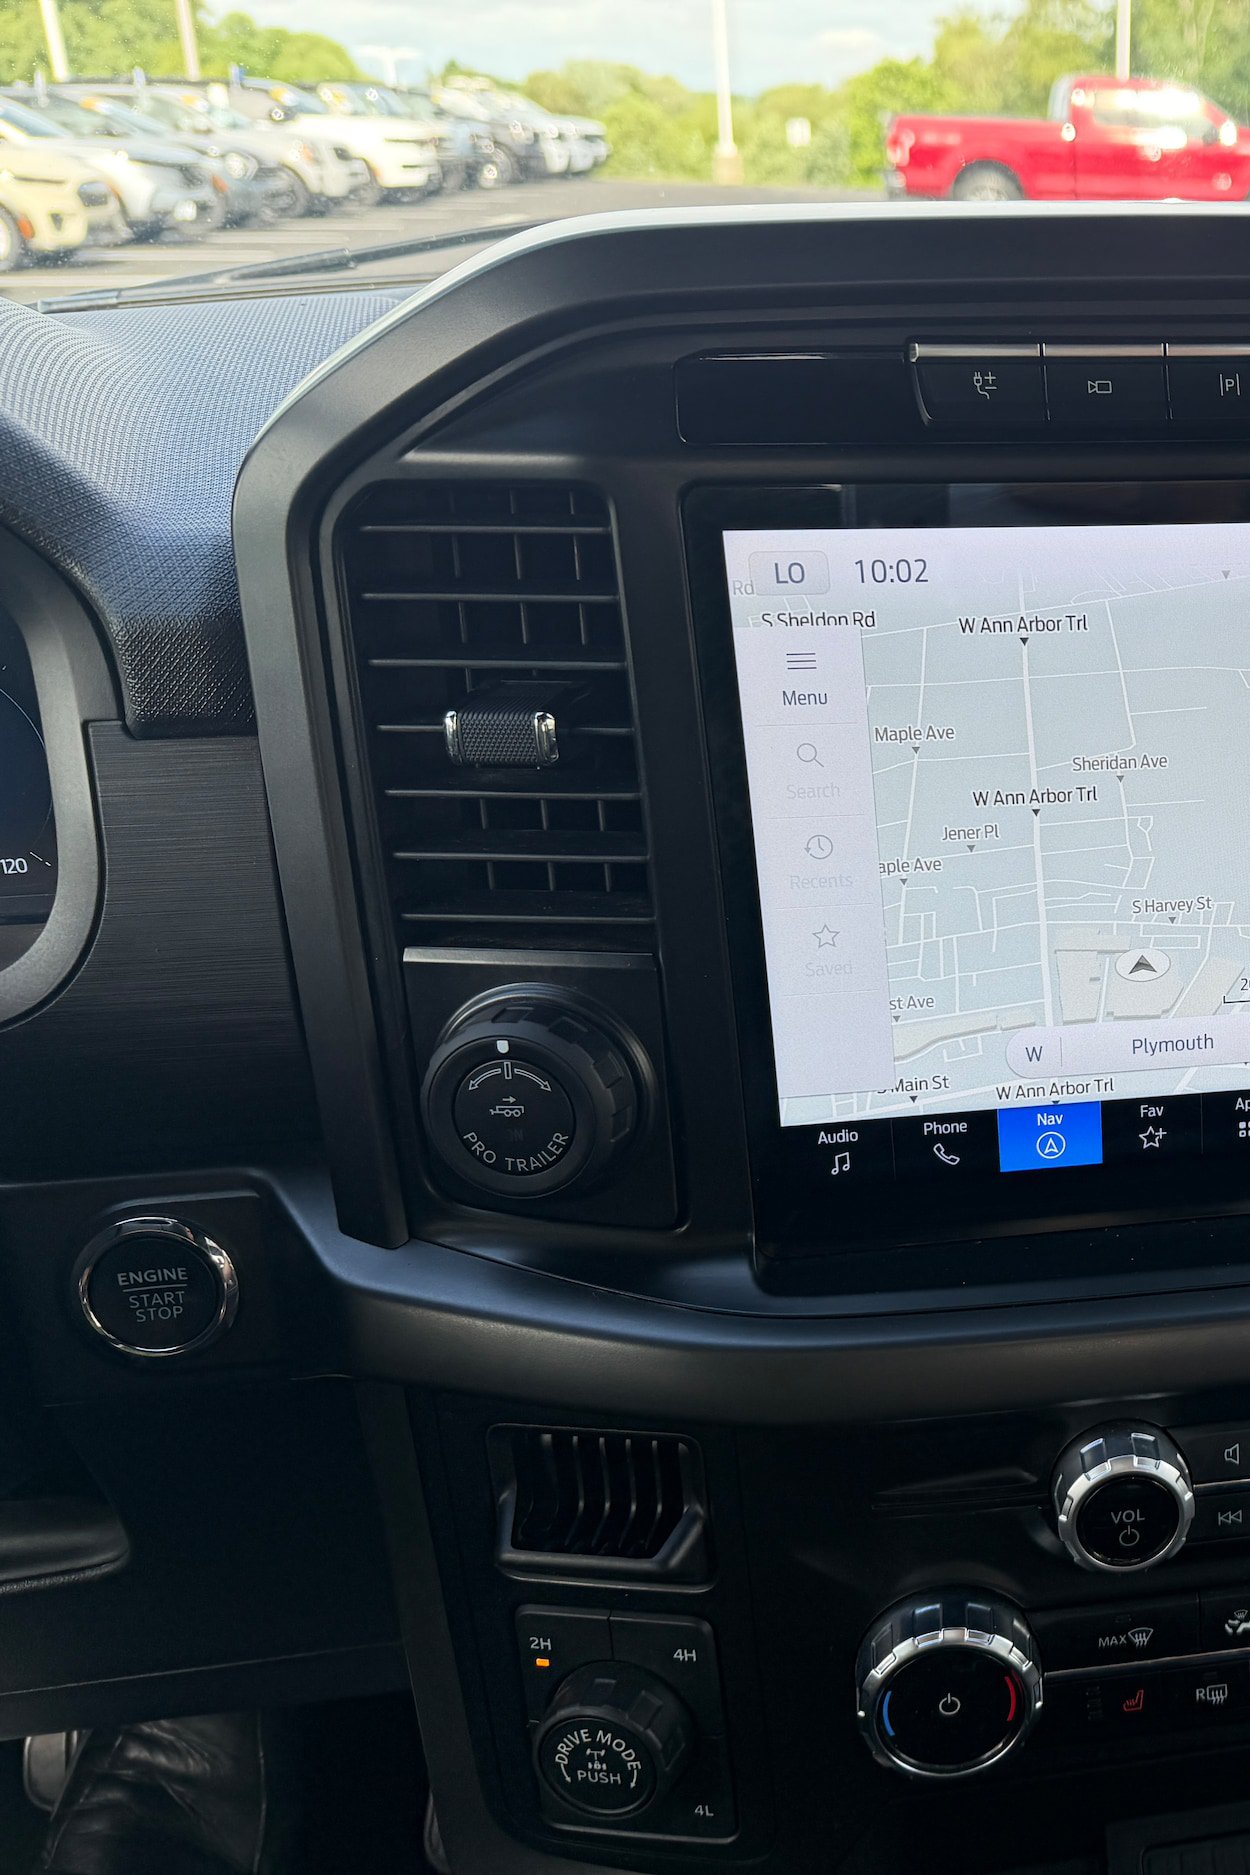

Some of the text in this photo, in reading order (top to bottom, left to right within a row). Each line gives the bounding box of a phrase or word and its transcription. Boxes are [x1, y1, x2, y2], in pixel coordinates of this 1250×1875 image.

[774, 562, 805, 584] LO
[854, 558, 929, 583] 10:02
[762, 611, 876, 627] S Sheldon Rd
[958, 614, 1088, 633] W Ann Arbor Trl
[782, 690, 828, 705] Menu
[874, 726, 955, 744] Maple Ave
[1072, 754, 1168, 771] Sheridan Ave
[786, 783, 841, 799] Search
[973, 786, 1098, 806] W Ann Arbor Trl
[942, 824, 999, 841] Jener Pl
[0, 858, 28, 874] 120
[914, 858, 942, 871] Ave
[790, 875, 853, 889] Recents
[1132, 897, 1212, 915] S Harvey St
[805, 962, 853, 978] Saved
[907, 996, 934, 1009] Ave
[1132, 1034, 1214, 1055] Plymouth
[1025, 1046, 1043, 1062] W
[932, 1075, 950, 1089] St
[996, 1078, 1114, 1101] W Ann Arbor Trl
[1037, 1112, 1063, 1126] Nav
[1140, 1105, 1164, 1118] Fav
[923, 1120, 968, 1135] Phone
[818, 1130, 858, 1145] Audio
[463, 1131, 569, 1172] PRO TRAILER
[117, 1268, 188, 1286] ENGINE
[129, 1291, 185, 1309] START
[136, 1306, 183, 1322] STOP
[1110, 1509, 1146, 1525] VOL
[529, 1637, 551, 1651] 2H
[1099, 1635, 1127, 1648] MAX
[673, 1649, 697, 1662] 4H
[1196, 1688, 1205, 1700] R
[555, 1729, 641, 1770] DRIVE MODE
[577, 1770, 621, 1785] PUSH
[694, 1805, 714, 1817] 4L
